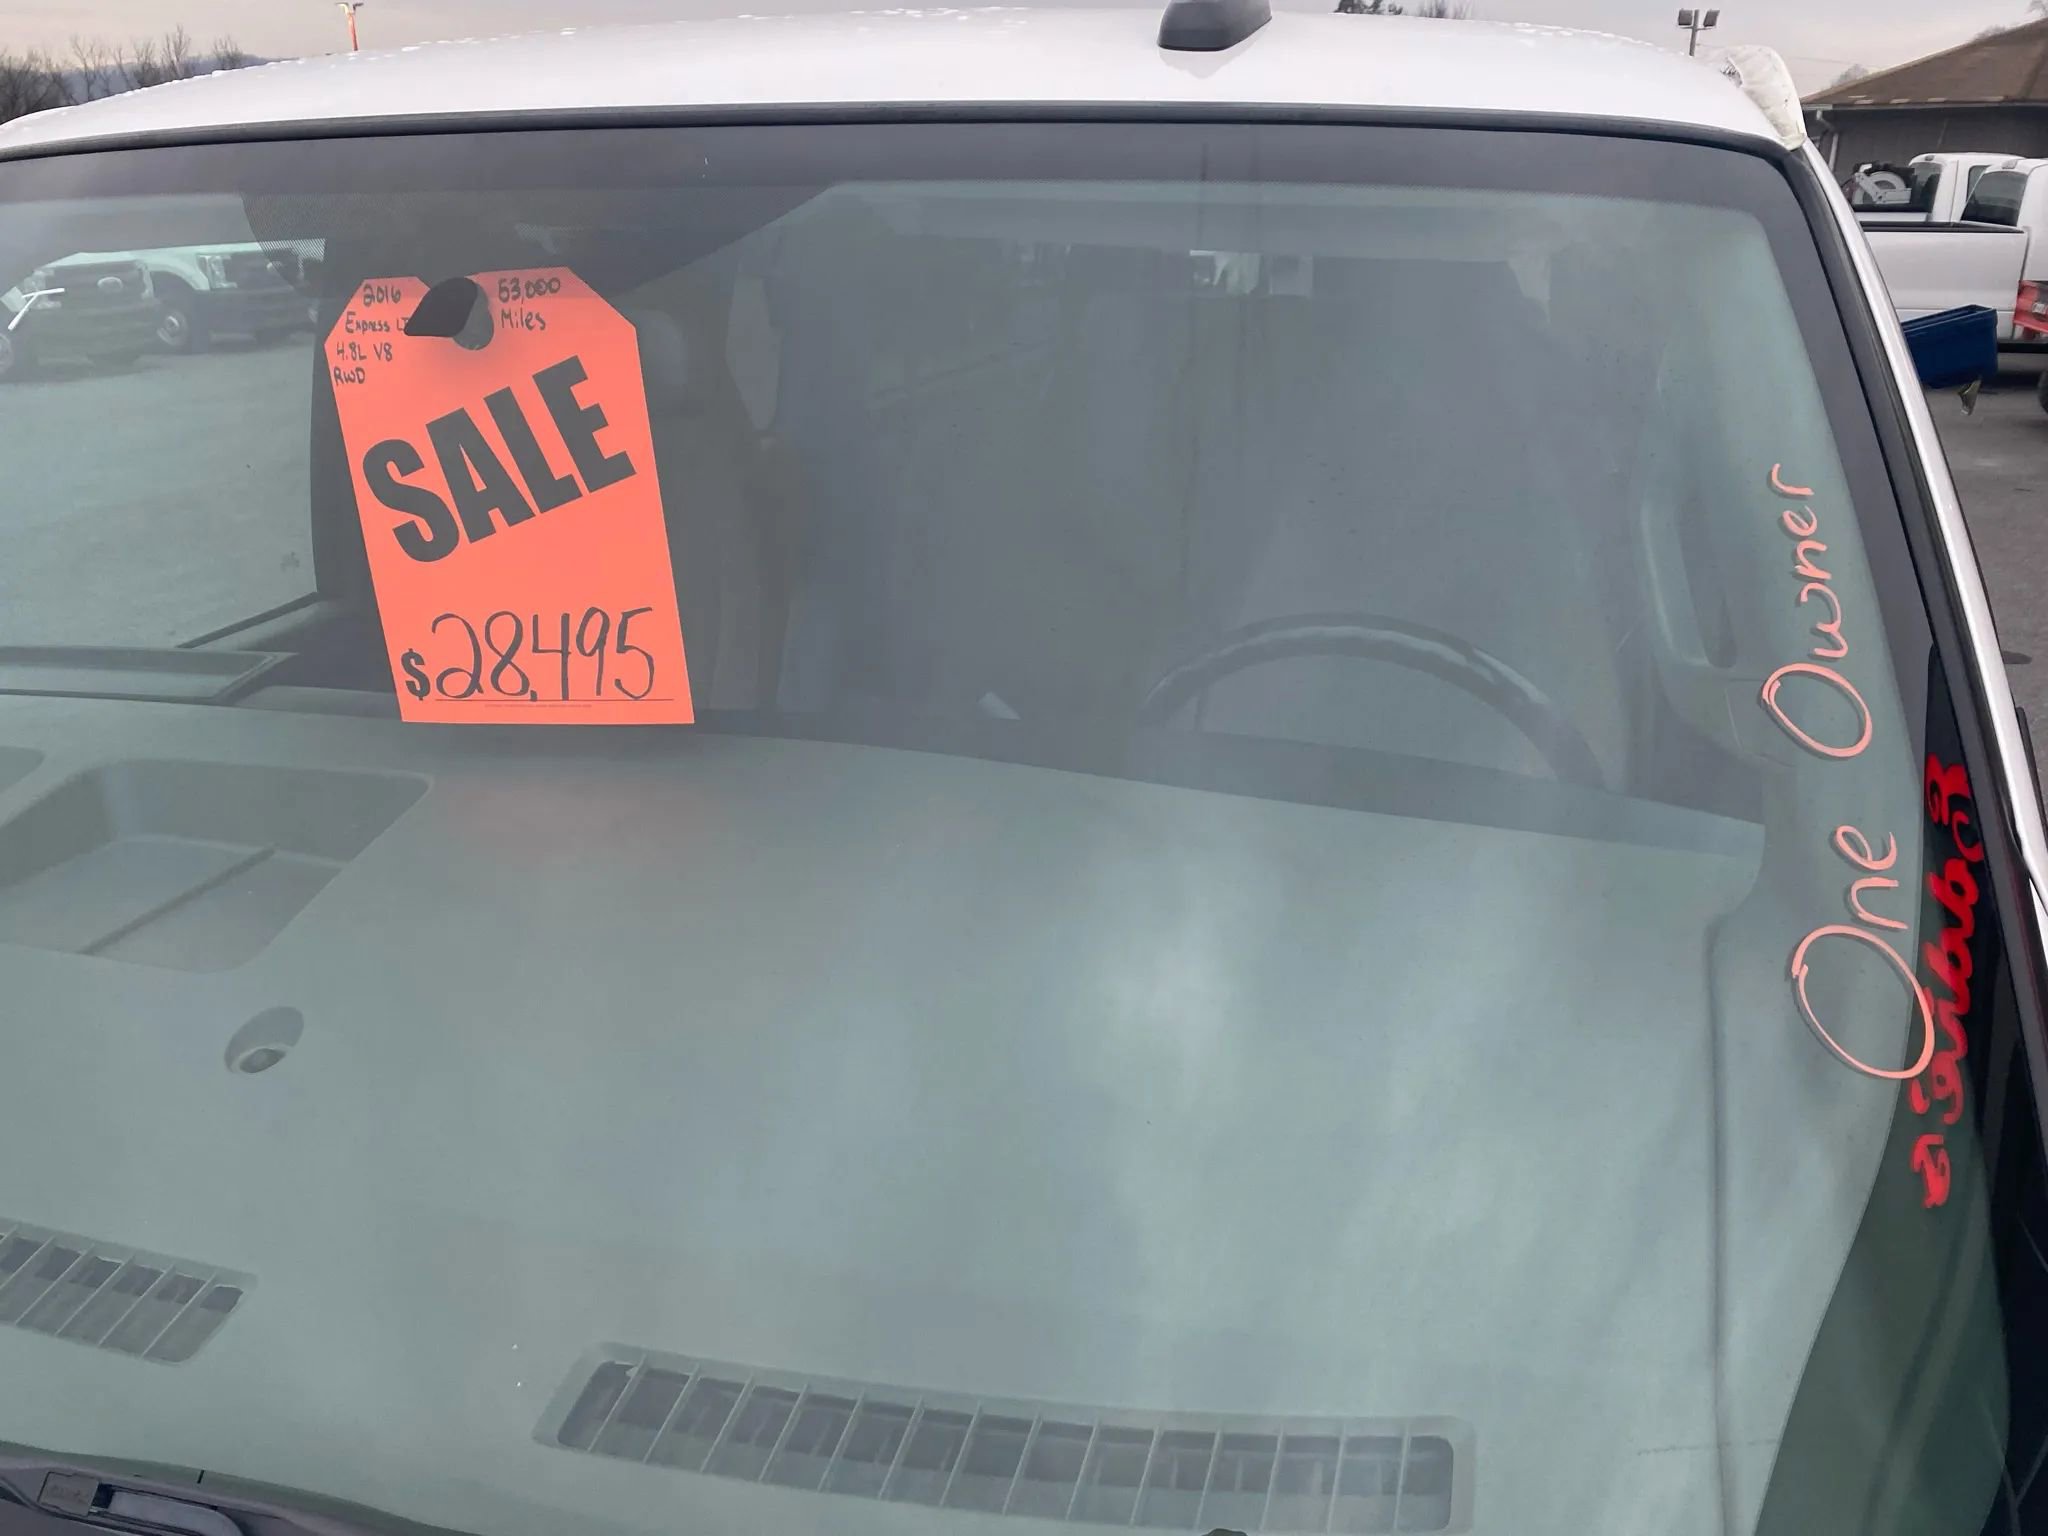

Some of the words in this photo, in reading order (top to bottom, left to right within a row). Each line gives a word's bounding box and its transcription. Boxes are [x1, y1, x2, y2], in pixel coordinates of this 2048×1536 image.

[363, 283, 401, 307] 2016
[345, 311, 391, 335] Express
[501, 308, 546, 331] Miles
[336, 341, 367, 361] 4.8L
[373, 342, 393, 362] V8
[333, 366, 366, 387] RWD
[362, 355, 638, 563] SALE
[1762, 463, 1873, 757] Owner
[1791, 824, 1935, 1079] One
